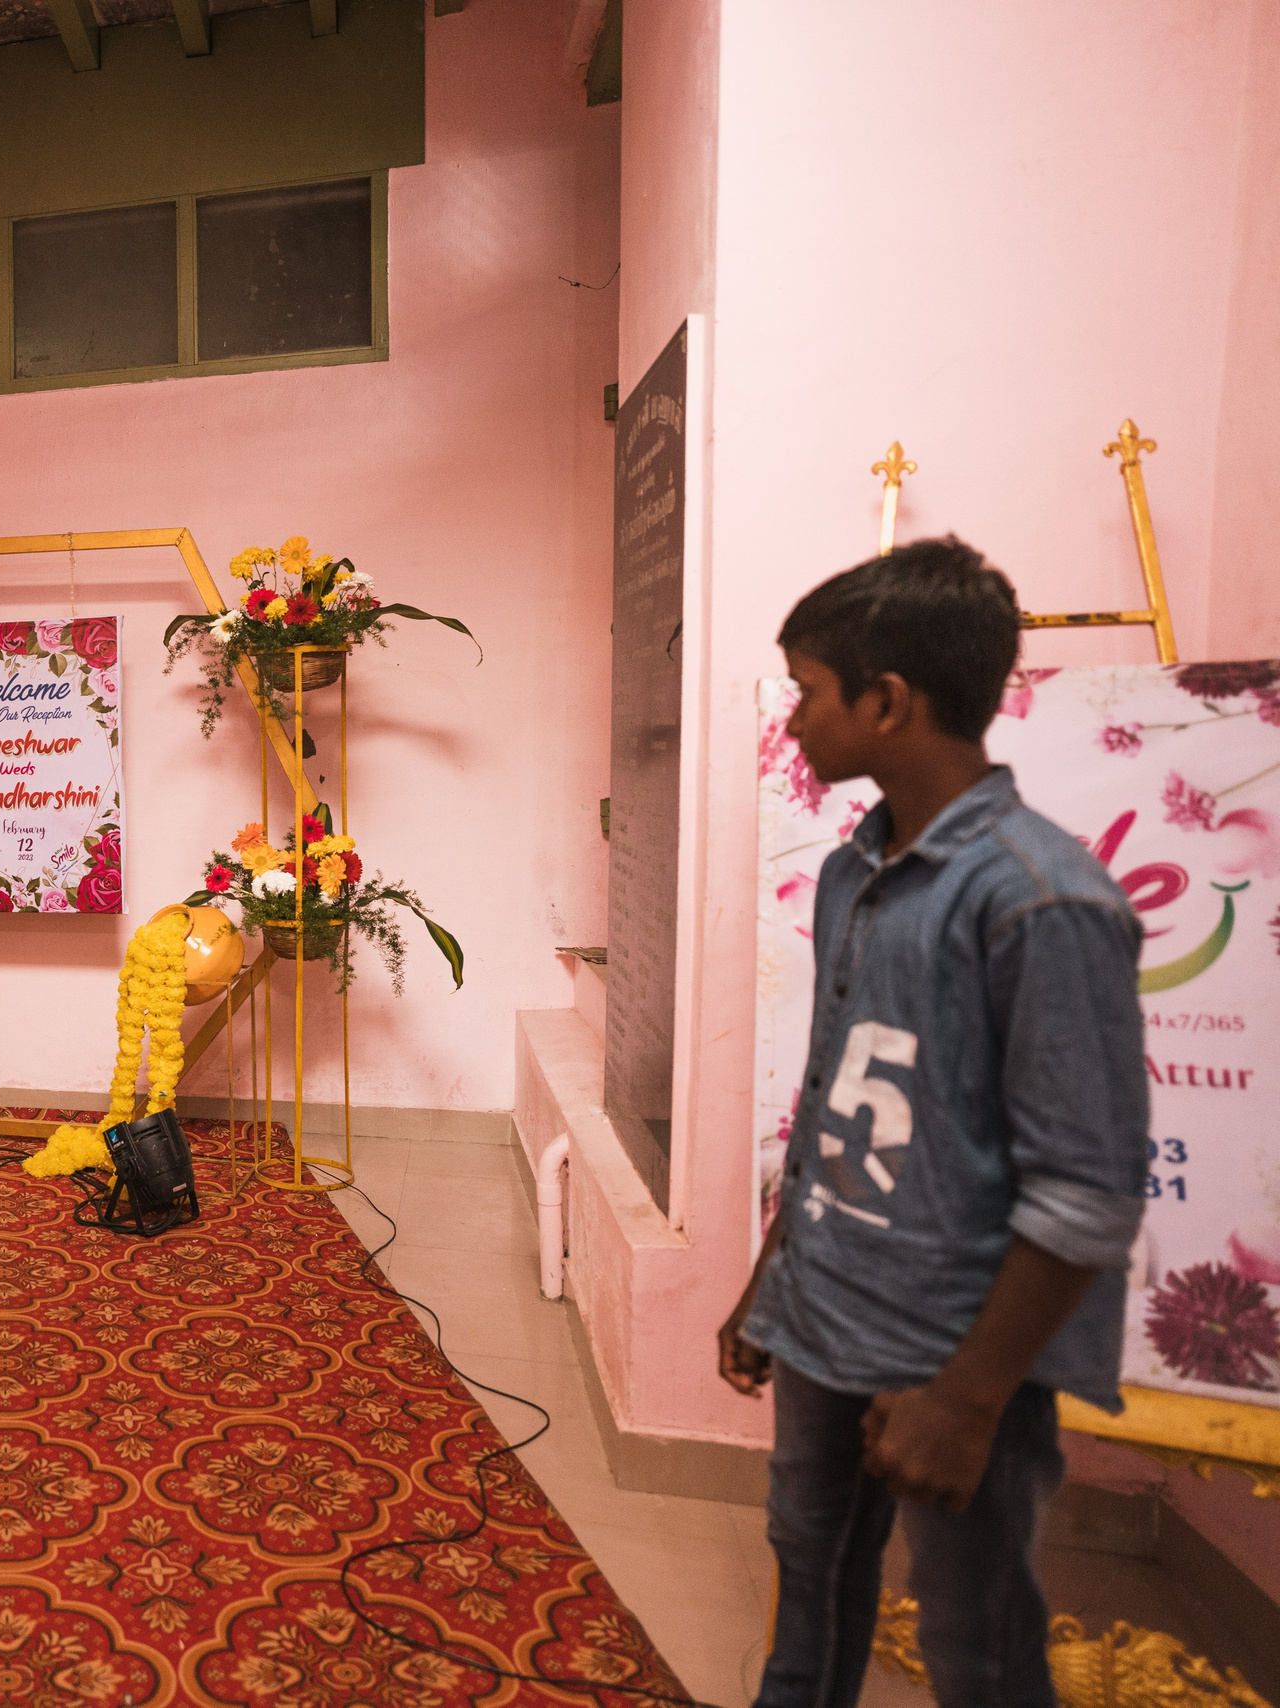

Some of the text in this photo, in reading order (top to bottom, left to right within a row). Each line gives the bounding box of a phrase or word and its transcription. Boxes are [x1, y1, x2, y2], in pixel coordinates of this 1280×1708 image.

[20, 706, 72, 724] Reception
[0, 761, 36, 776] Weds
[3, 819, 46, 840] February
[17, 838, 34, 852] 12
[51, 844, 76, 870] Smile
